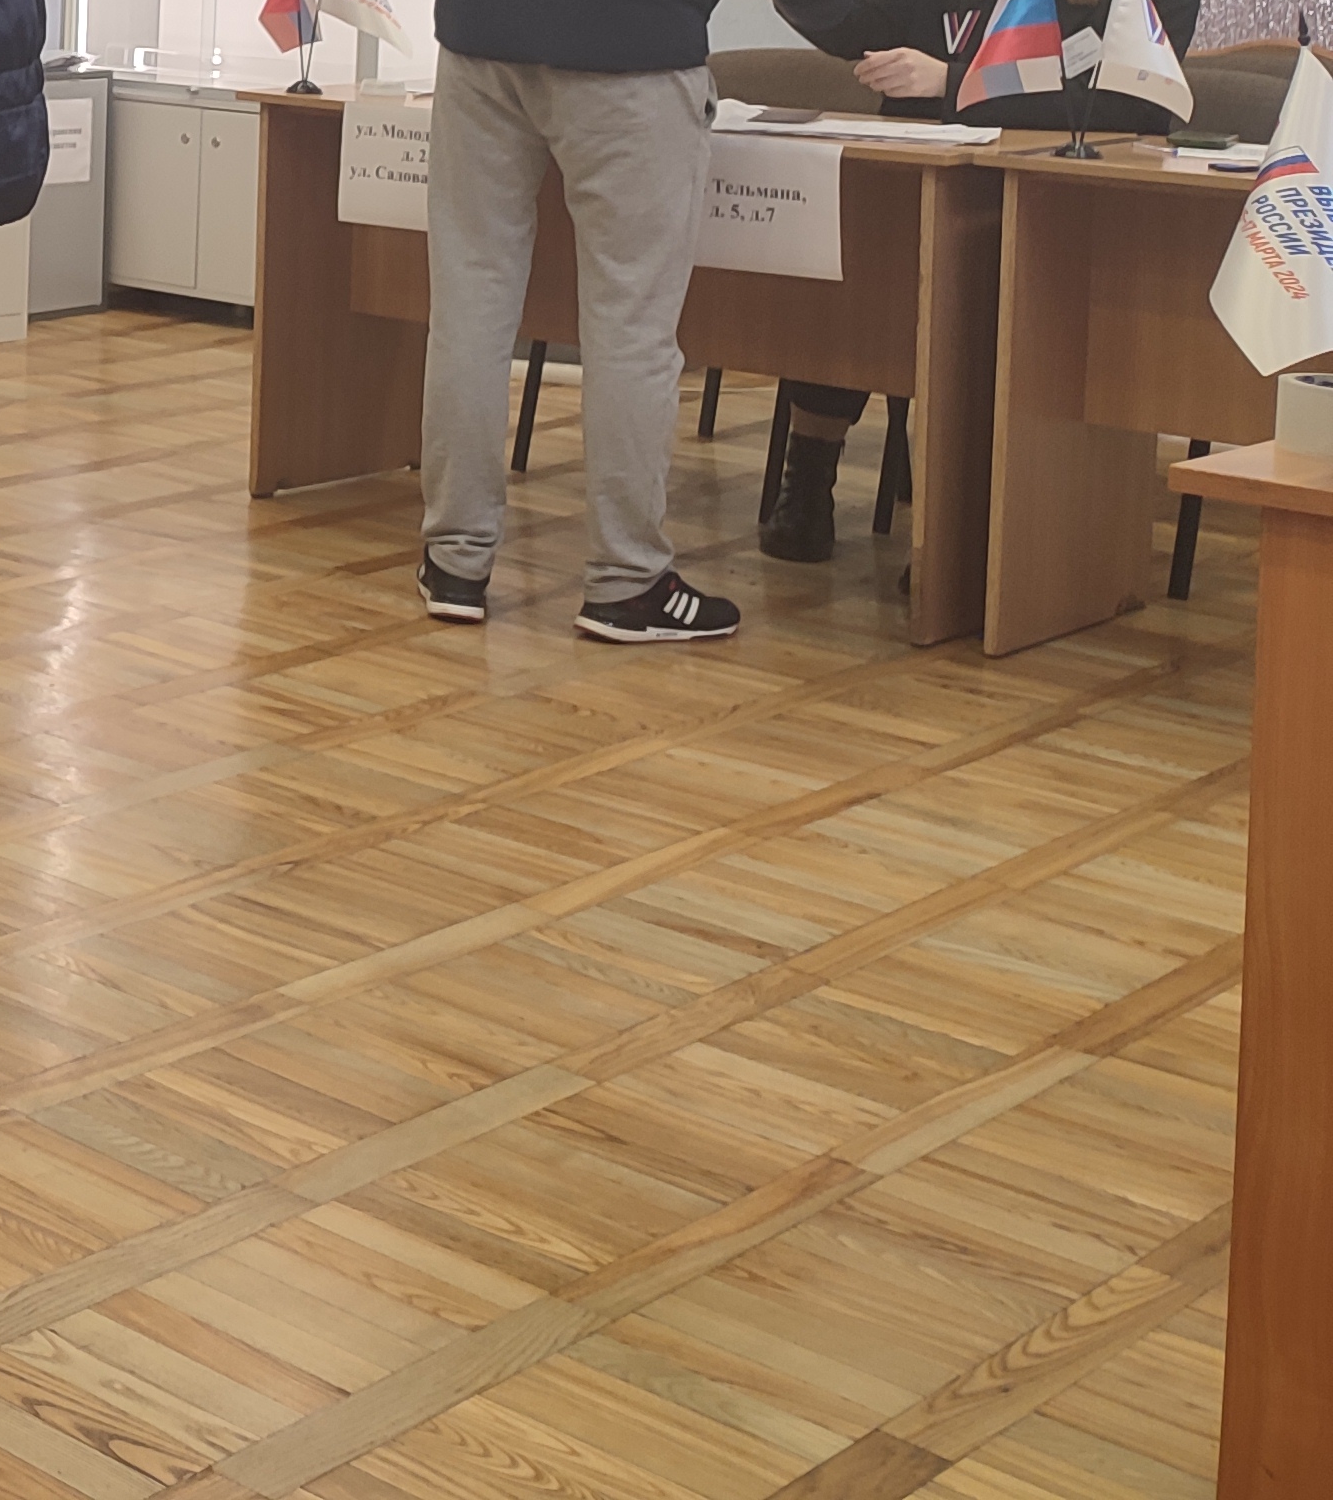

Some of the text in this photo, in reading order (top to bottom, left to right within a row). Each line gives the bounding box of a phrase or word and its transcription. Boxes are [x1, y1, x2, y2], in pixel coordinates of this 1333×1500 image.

[355, 124, 430, 142] ул. Молод
[400, 150, 414, 162] д.
[349, 165, 428, 184] ул. Садова
[712, 178, 807, 205] Тельмана,
[710, 205, 725, 218] д.
[750, 207, 775, 222] д.7
[1251, 194, 1312, 255] РОССИИ
[1246, 231, 1286, 269] МАРТА
[1273, 270, 1309, 299] 2024
